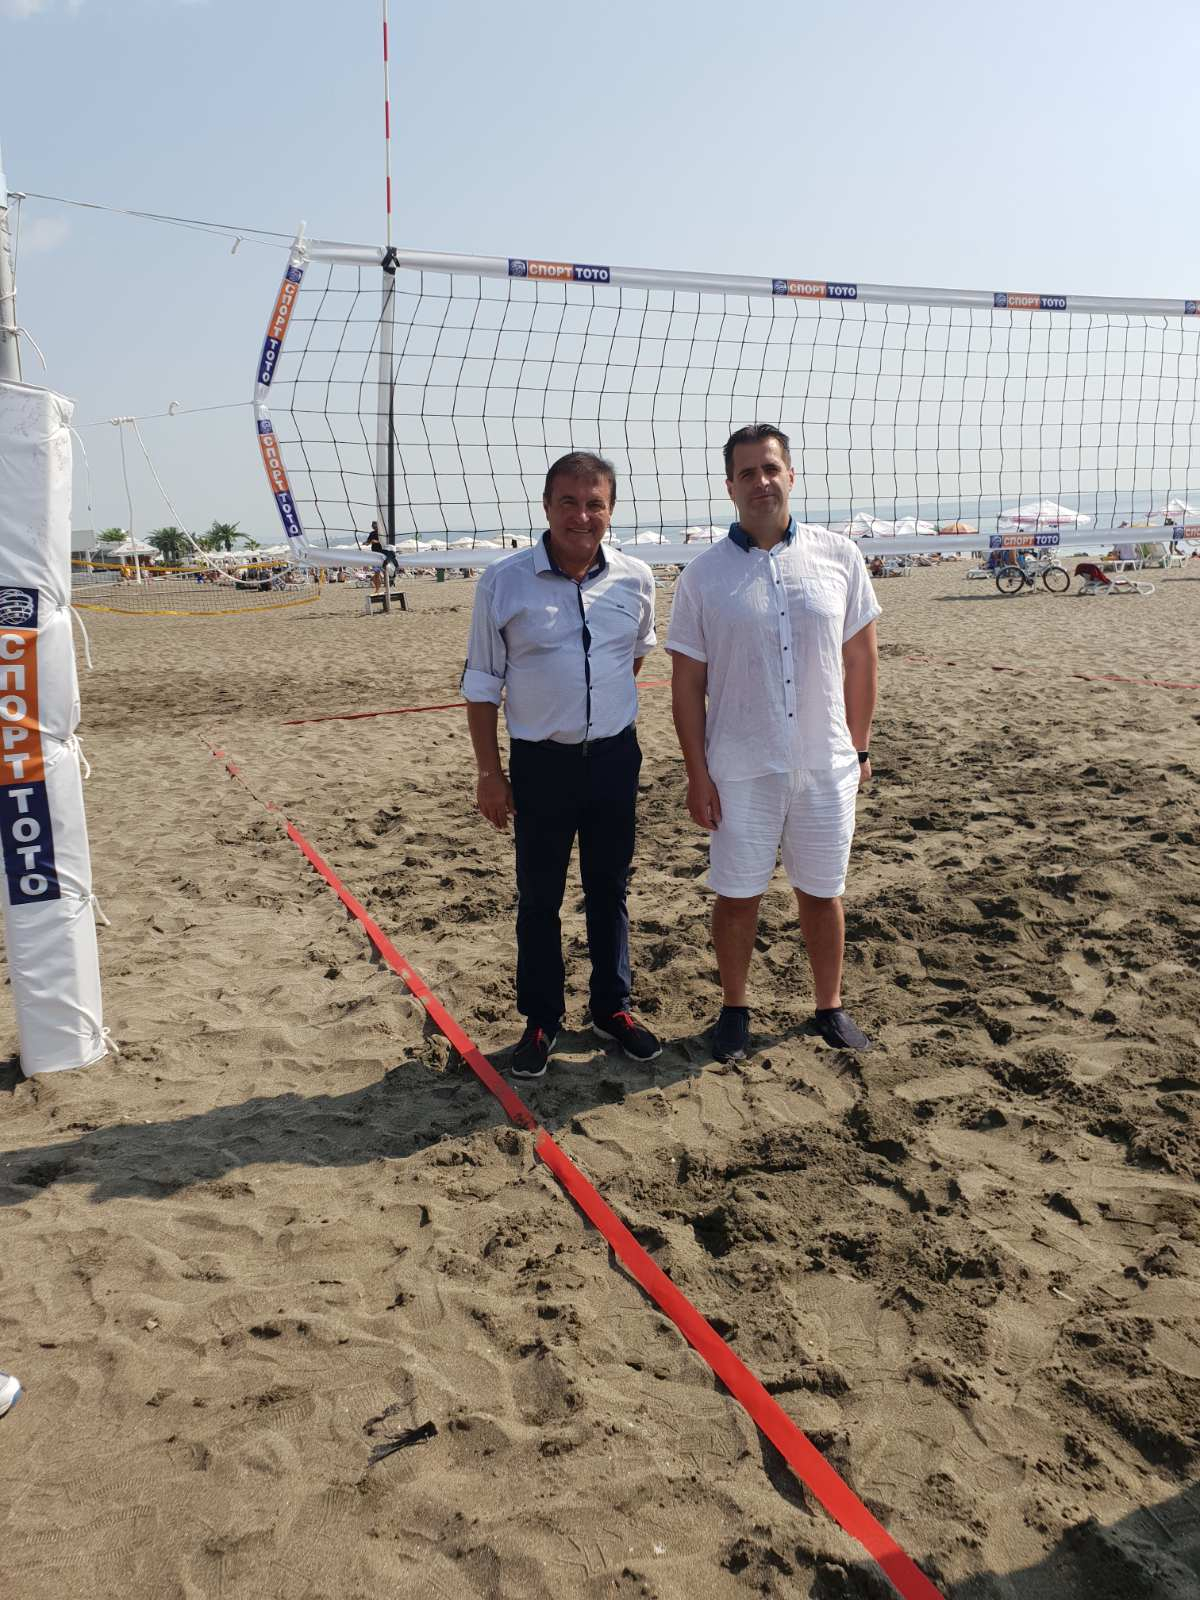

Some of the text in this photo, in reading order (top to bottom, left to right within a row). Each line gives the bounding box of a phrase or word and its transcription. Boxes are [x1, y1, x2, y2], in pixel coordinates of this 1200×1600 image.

[529, 264, 608, 280] СПОРТ ТОТО
[790, 283, 856, 297] СПОРТ ТОТО
[1009, 296, 1066, 308] СПОРТ ТОТО
[262, 283, 296, 383] СПОРТ ТОТО
[264, 436, 299, 534] СПОРТ ТОТО
[1004, 535, 1059, 546] СПОРТ ТОТО
[0, 634, 49, 897] СПОРТ ТОТО
